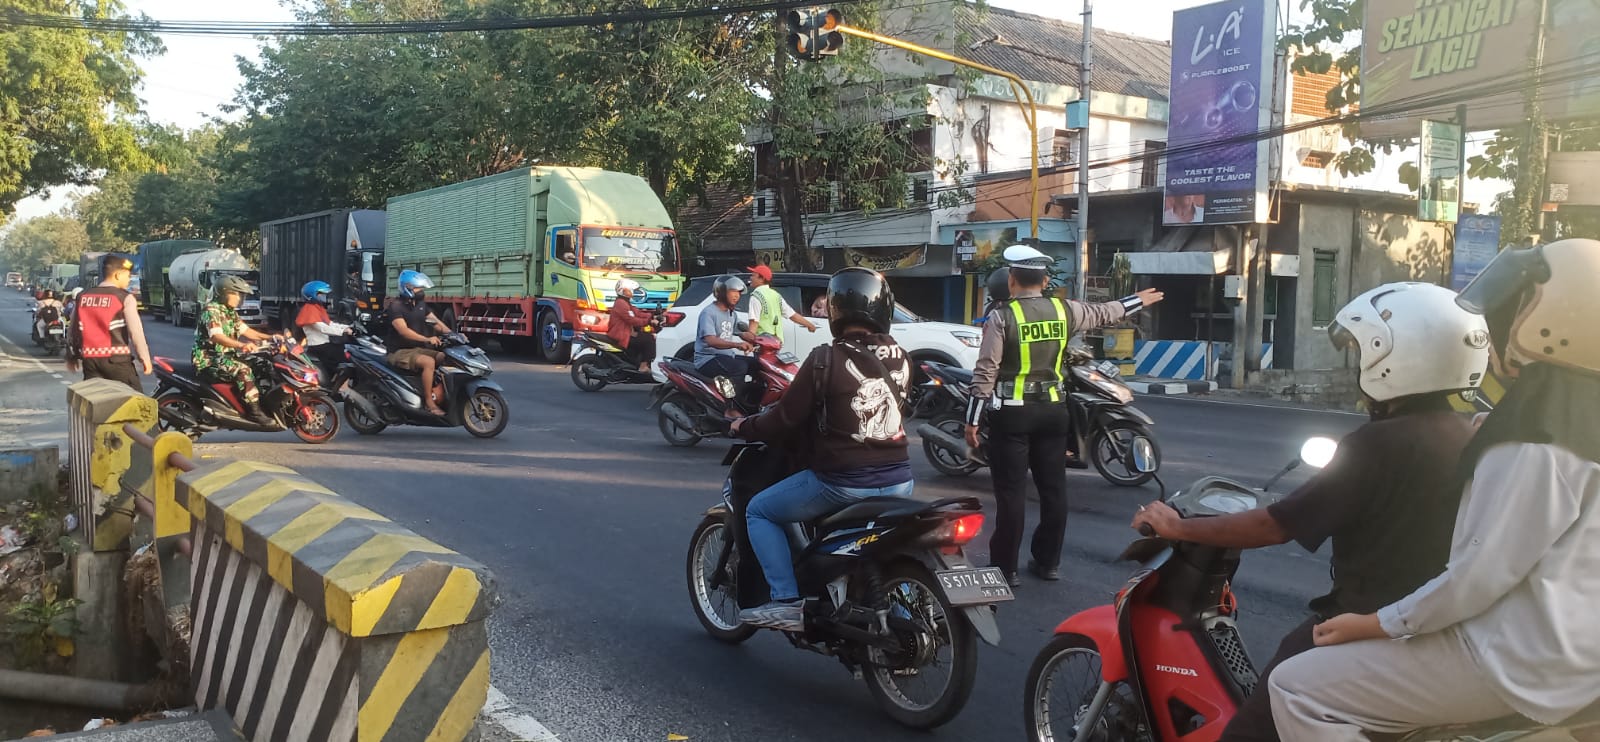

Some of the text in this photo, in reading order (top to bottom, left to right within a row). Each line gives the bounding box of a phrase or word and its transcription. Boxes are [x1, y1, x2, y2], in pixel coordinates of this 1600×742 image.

[1378, 0, 1516, 53] SEMANGAT
[1223, 47, 1241, 56] ICE
[1185, 165, 1236, 176] TASTE THE
[1170, 172, 1252, 185] COOLEST FLAVOR
[80, 296, 111, 308] POLISI
[1021, 322, 1064, 341] POLISI
[943, 572, 1001, 588] S 5174 ABL
[1156, 664, 1198, 677] HONDA
